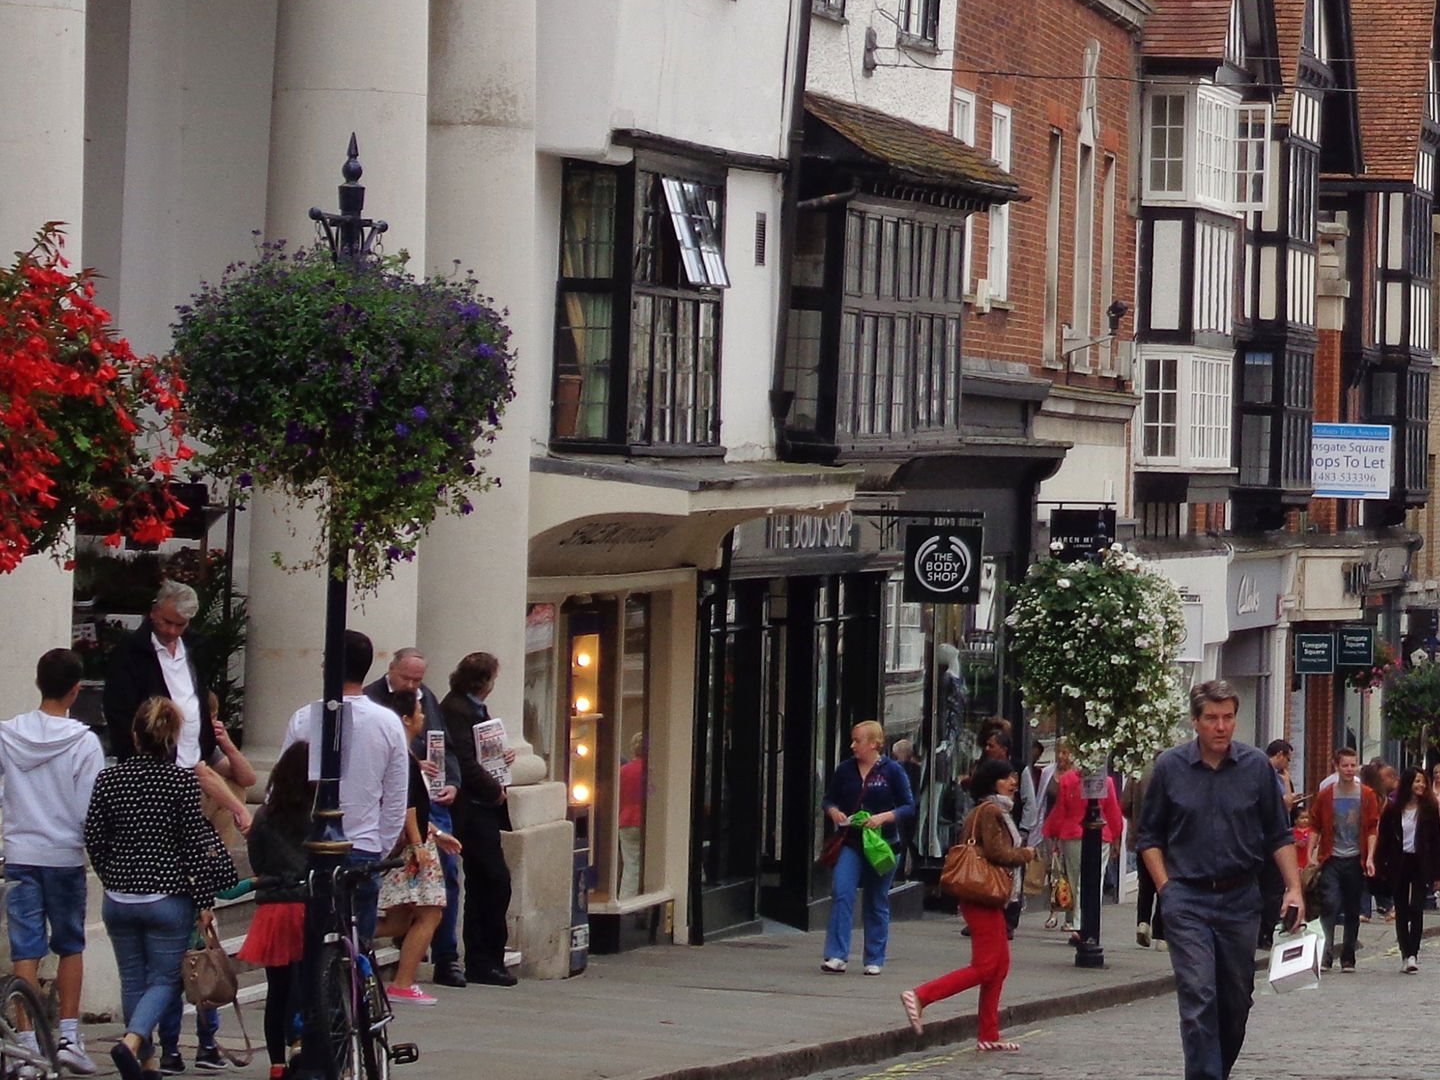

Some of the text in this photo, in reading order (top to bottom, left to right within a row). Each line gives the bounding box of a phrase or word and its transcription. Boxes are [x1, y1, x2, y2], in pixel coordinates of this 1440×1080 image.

[1312, 442, 1385, 454] nsgate Square
[1343, 455, 1360, 468] To
[1364, 456, 1385, 469] Let
[1340, 473, 1376, 483] 533396
[793, 513, 822, 549] BODY
[933, 552, 953, 561] THE
[925, 561, 960, 572] BODY
[927, 571, 958, 582] SHOP
